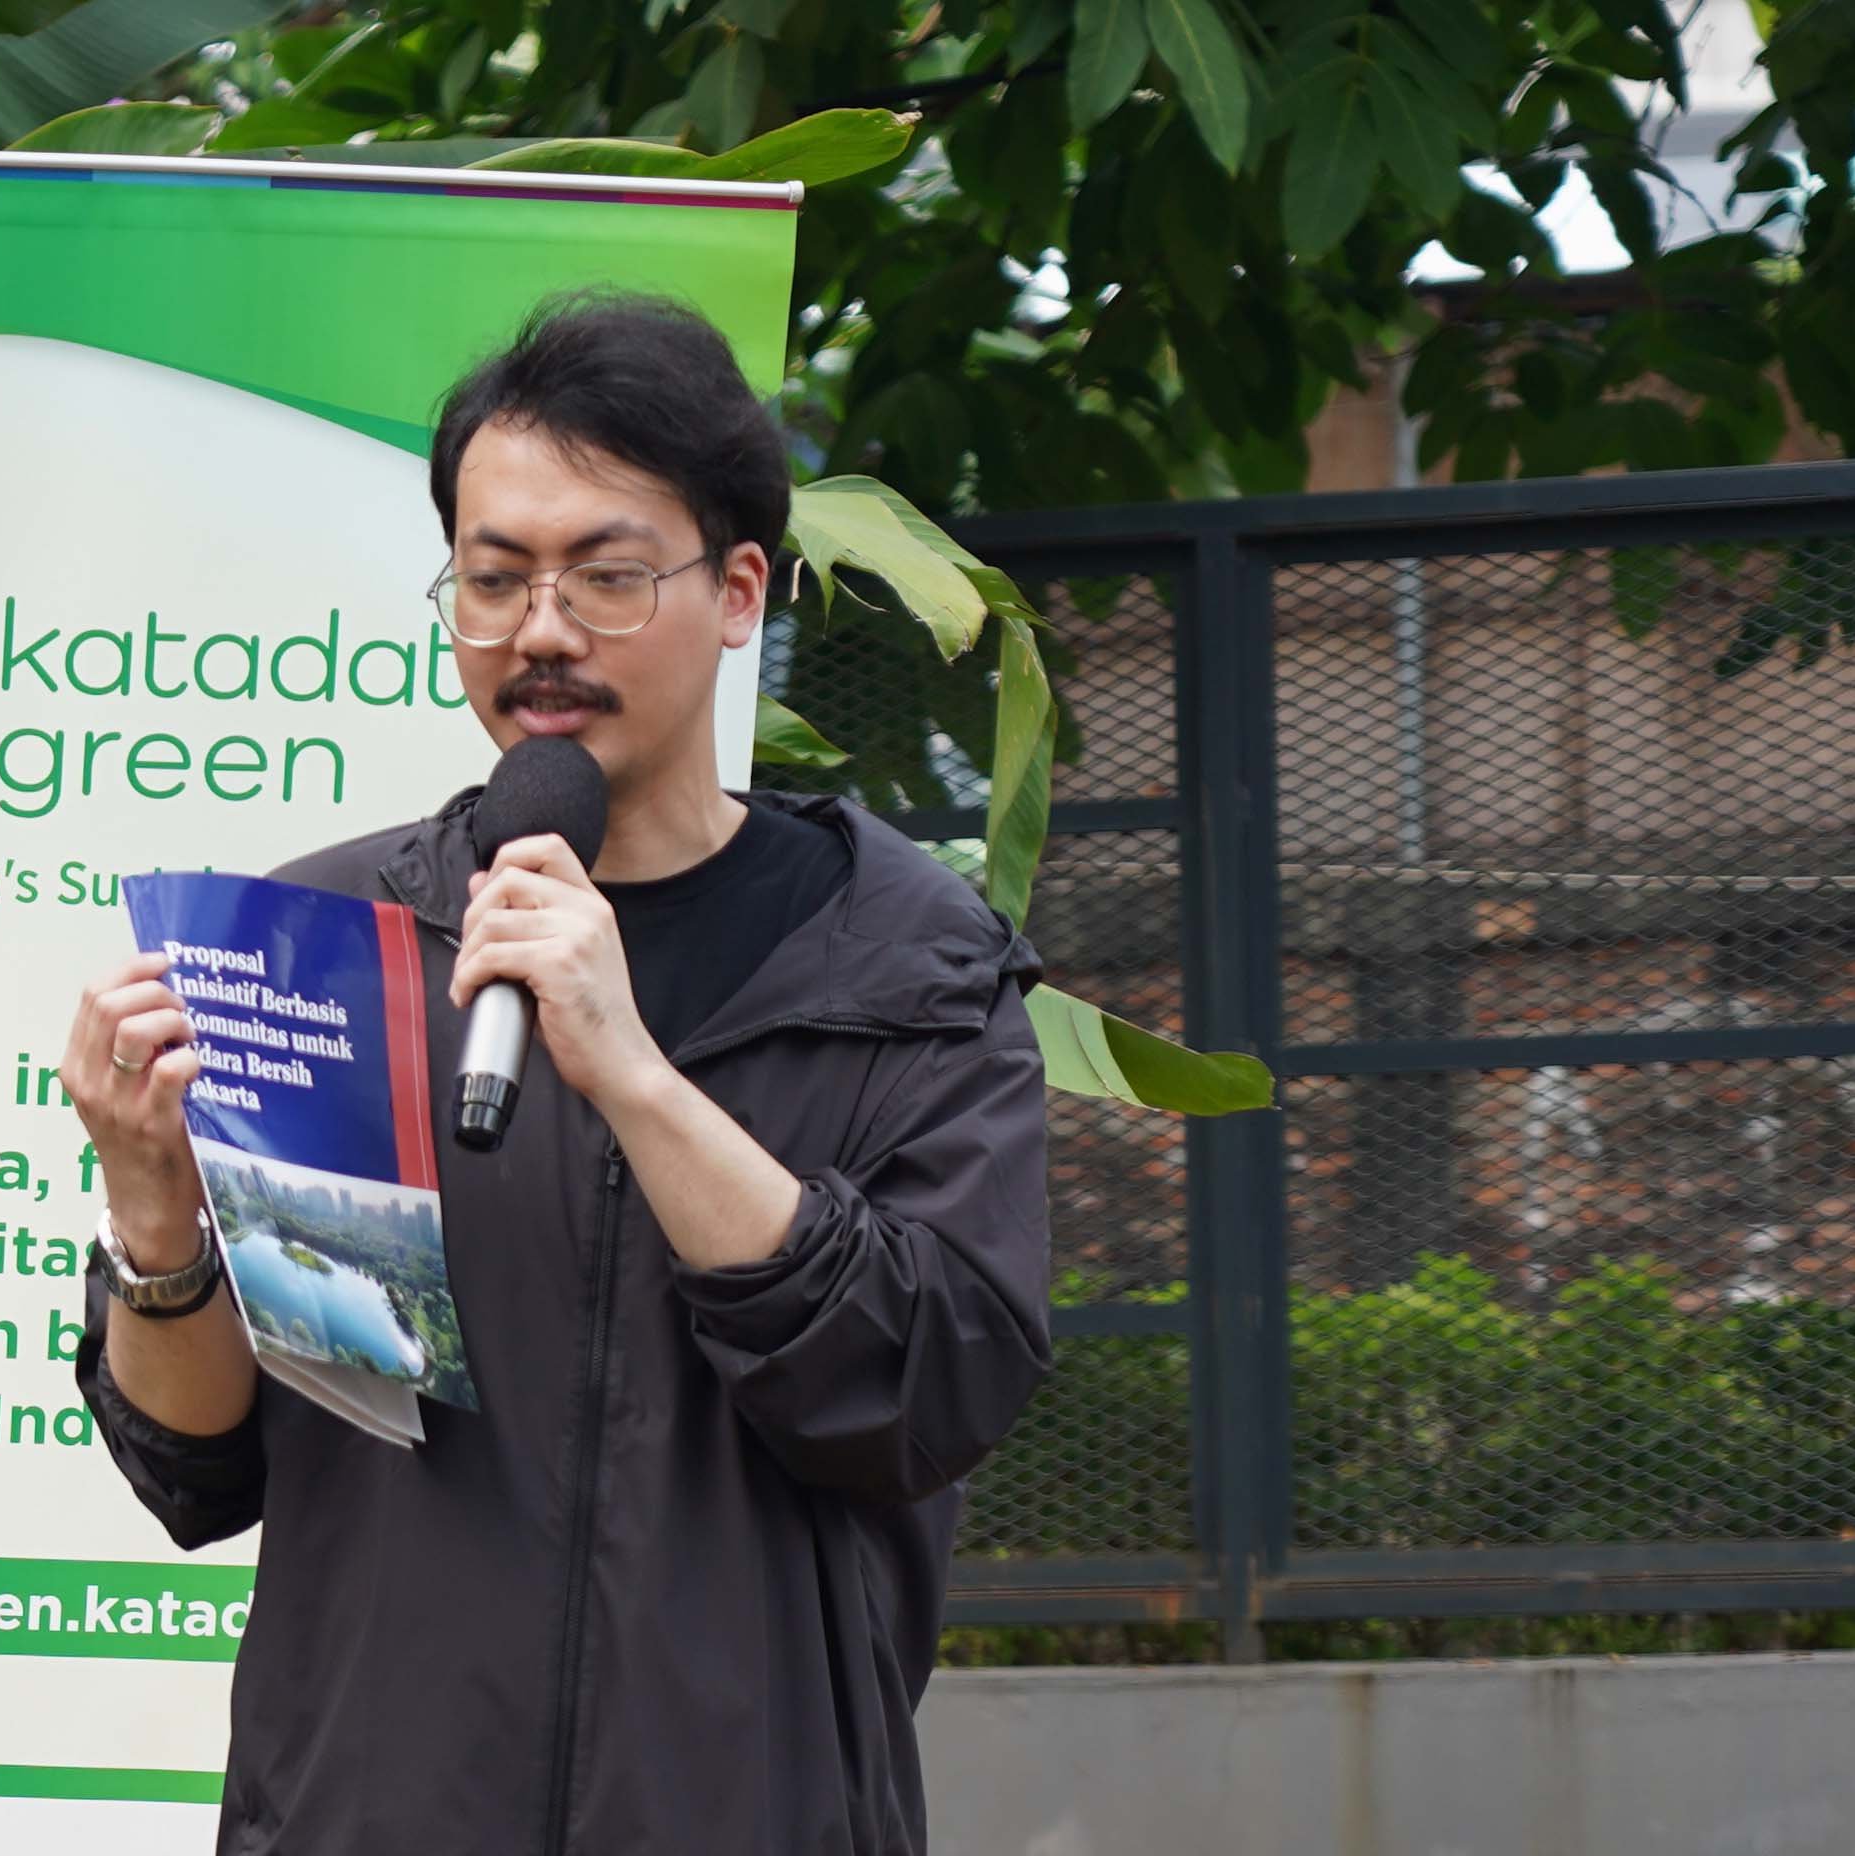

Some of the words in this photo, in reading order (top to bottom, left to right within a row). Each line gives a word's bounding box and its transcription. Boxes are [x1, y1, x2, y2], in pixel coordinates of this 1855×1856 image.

[1, 597, 468, 709] katadat
[162, 940, 266, 976] Proposal
[171, 972, 259, 1009] Inisiatif
[262, 986, 347, 1024] Berbasis
[292, 1031, 355, 1061] untuk
[247, 1051, 314, 1088] Bersih
